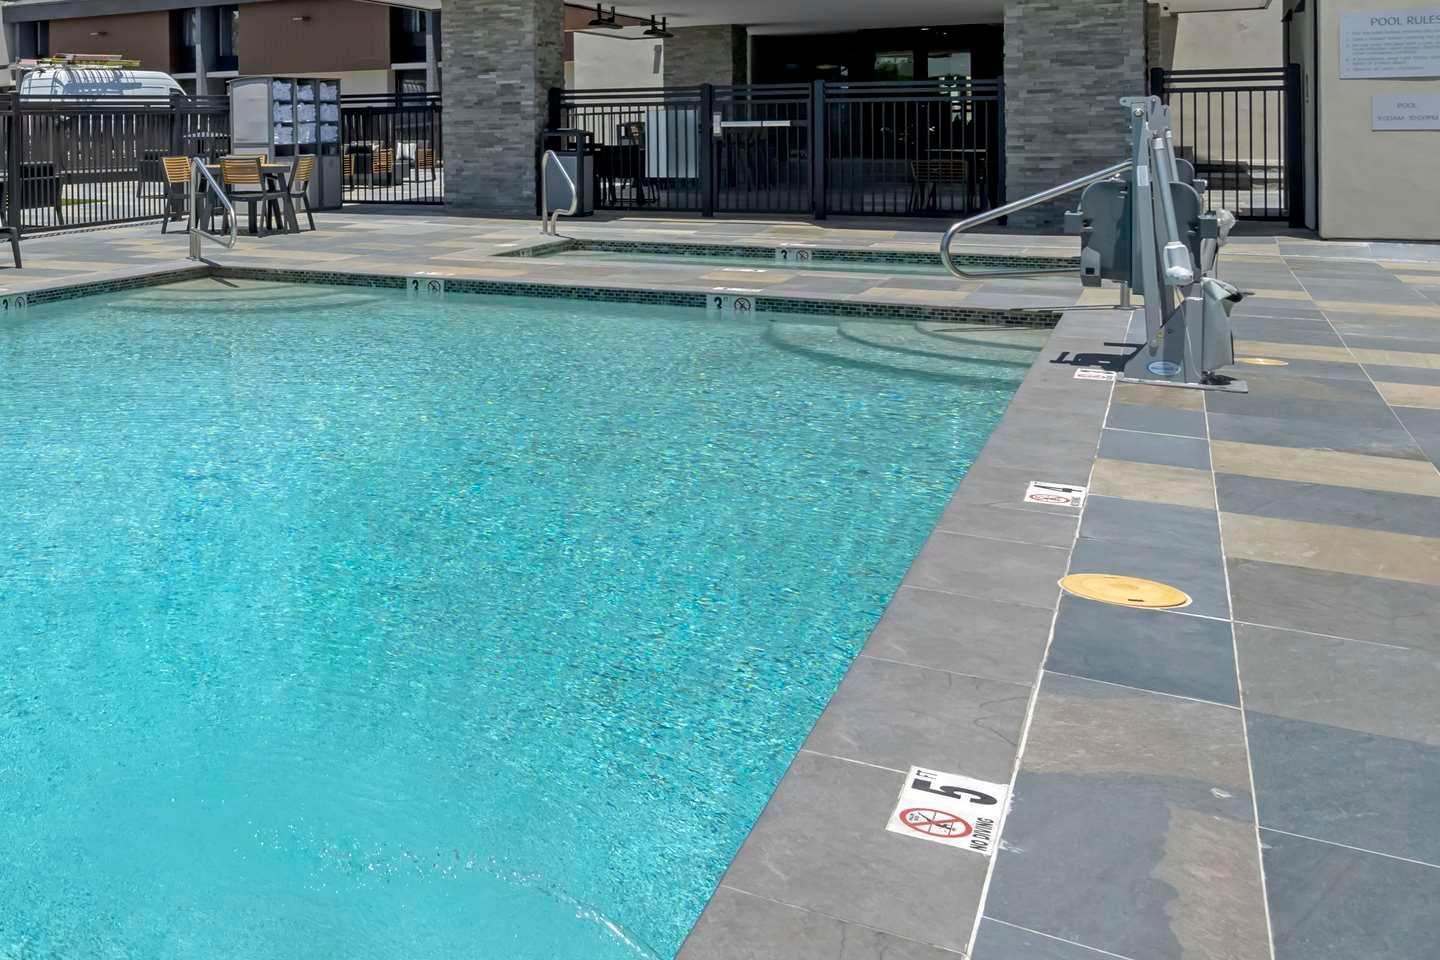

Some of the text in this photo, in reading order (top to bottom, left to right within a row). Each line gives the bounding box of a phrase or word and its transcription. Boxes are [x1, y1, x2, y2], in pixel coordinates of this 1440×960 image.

[1370, 14, 1440, 27] POOL RULES
[911, 778, 997, 805] 5
[969, 817, 994, 852] NO DIVING
